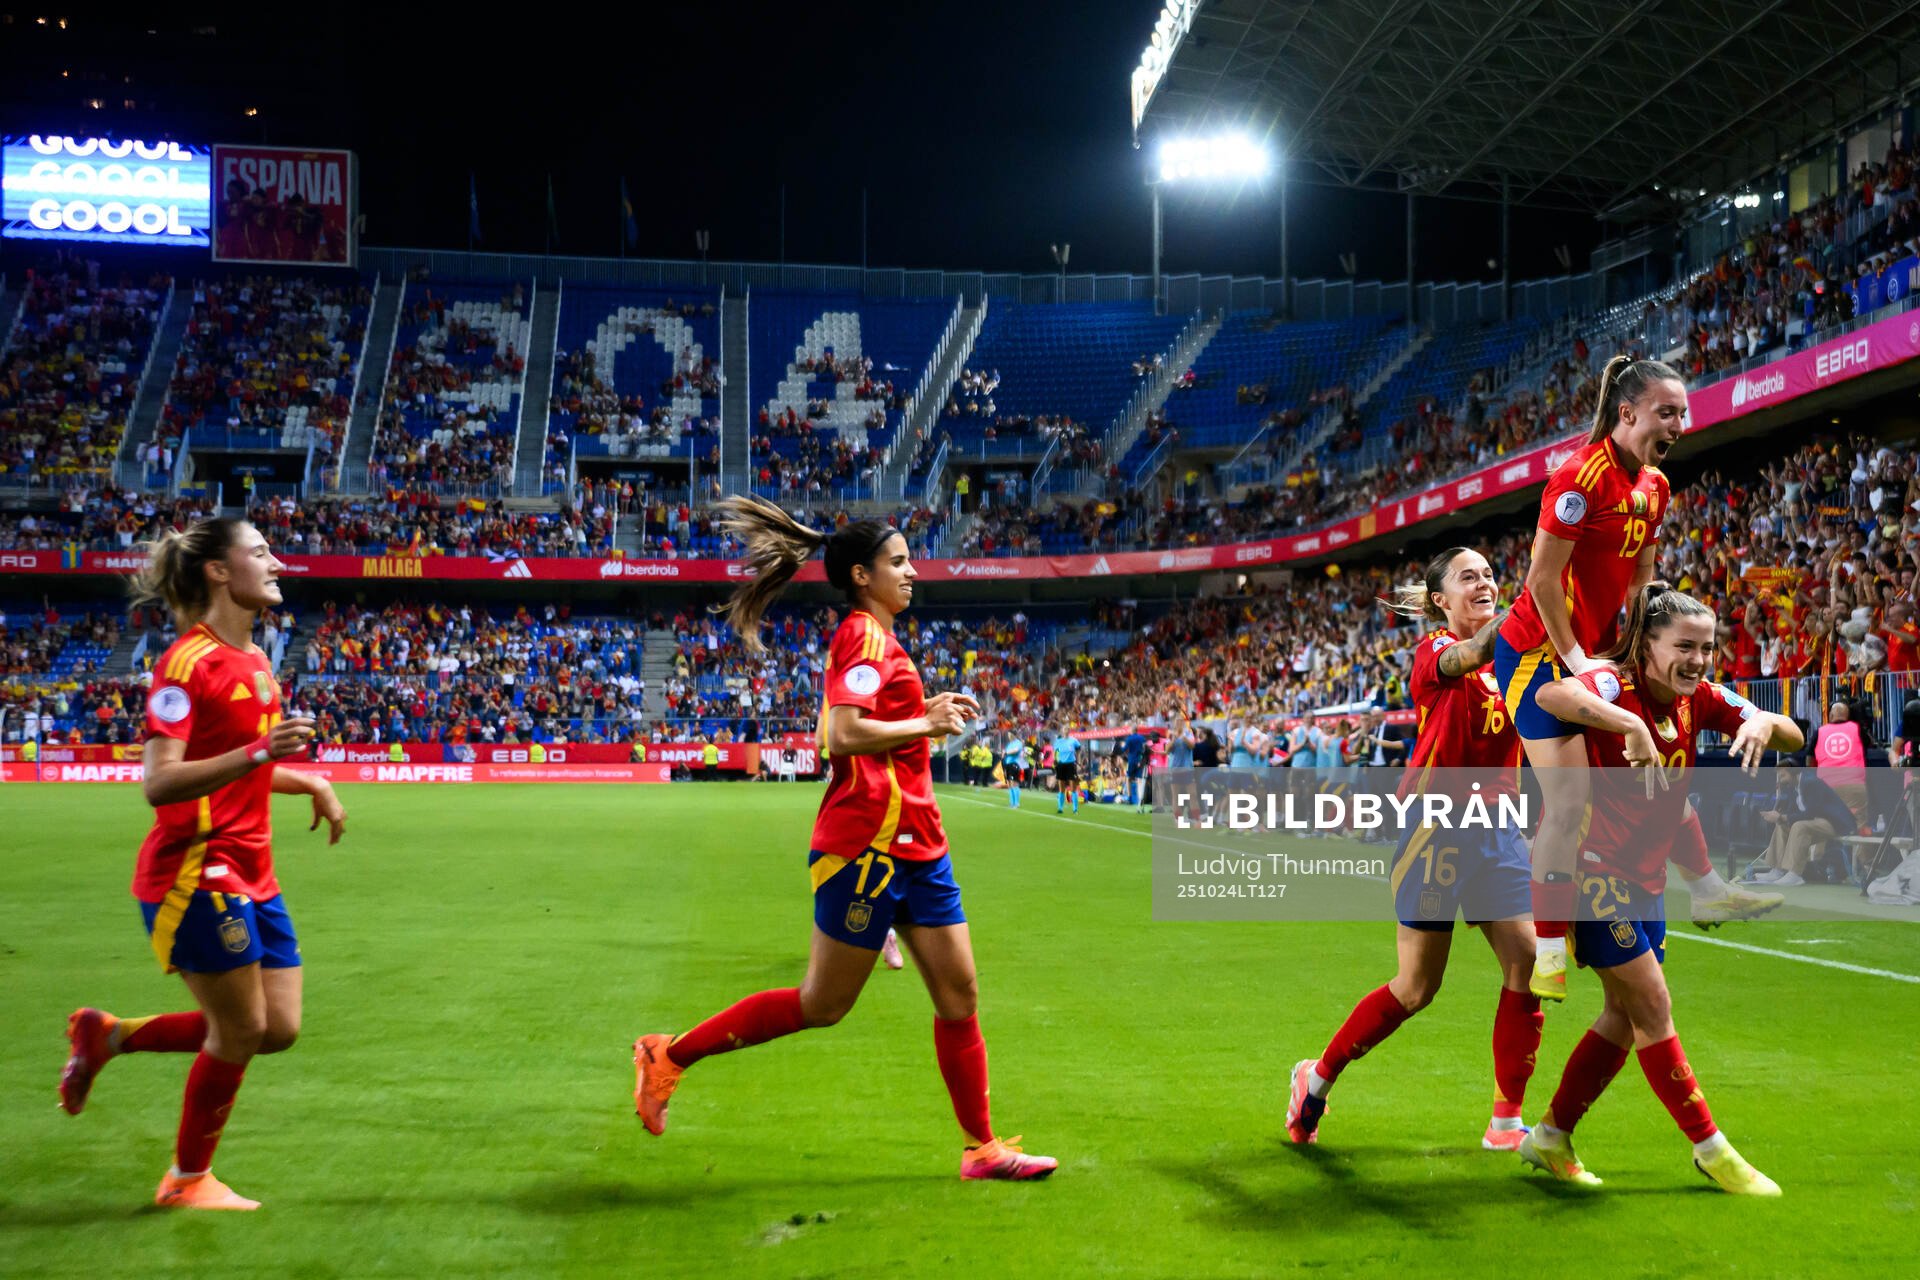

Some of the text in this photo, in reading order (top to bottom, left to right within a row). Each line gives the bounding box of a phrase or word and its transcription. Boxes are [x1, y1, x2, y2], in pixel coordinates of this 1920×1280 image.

[28, 199, 192, 235] GOOOL
[1748, 373, 1785, 400] Iberdrola
[1618, 517, 1647, 558] 19
[363, 556, 423, 577] MÁLAGA
[624, 564, 679, 576] Iberdrola
[491, 750, 566, 762] EBO
[661, 751, 729, 762] MAPFE
[378, 766, 473, 781] MAPFRE
[854, 851, 895, 898] 17
[1419, 843, 1460, 887] 16
